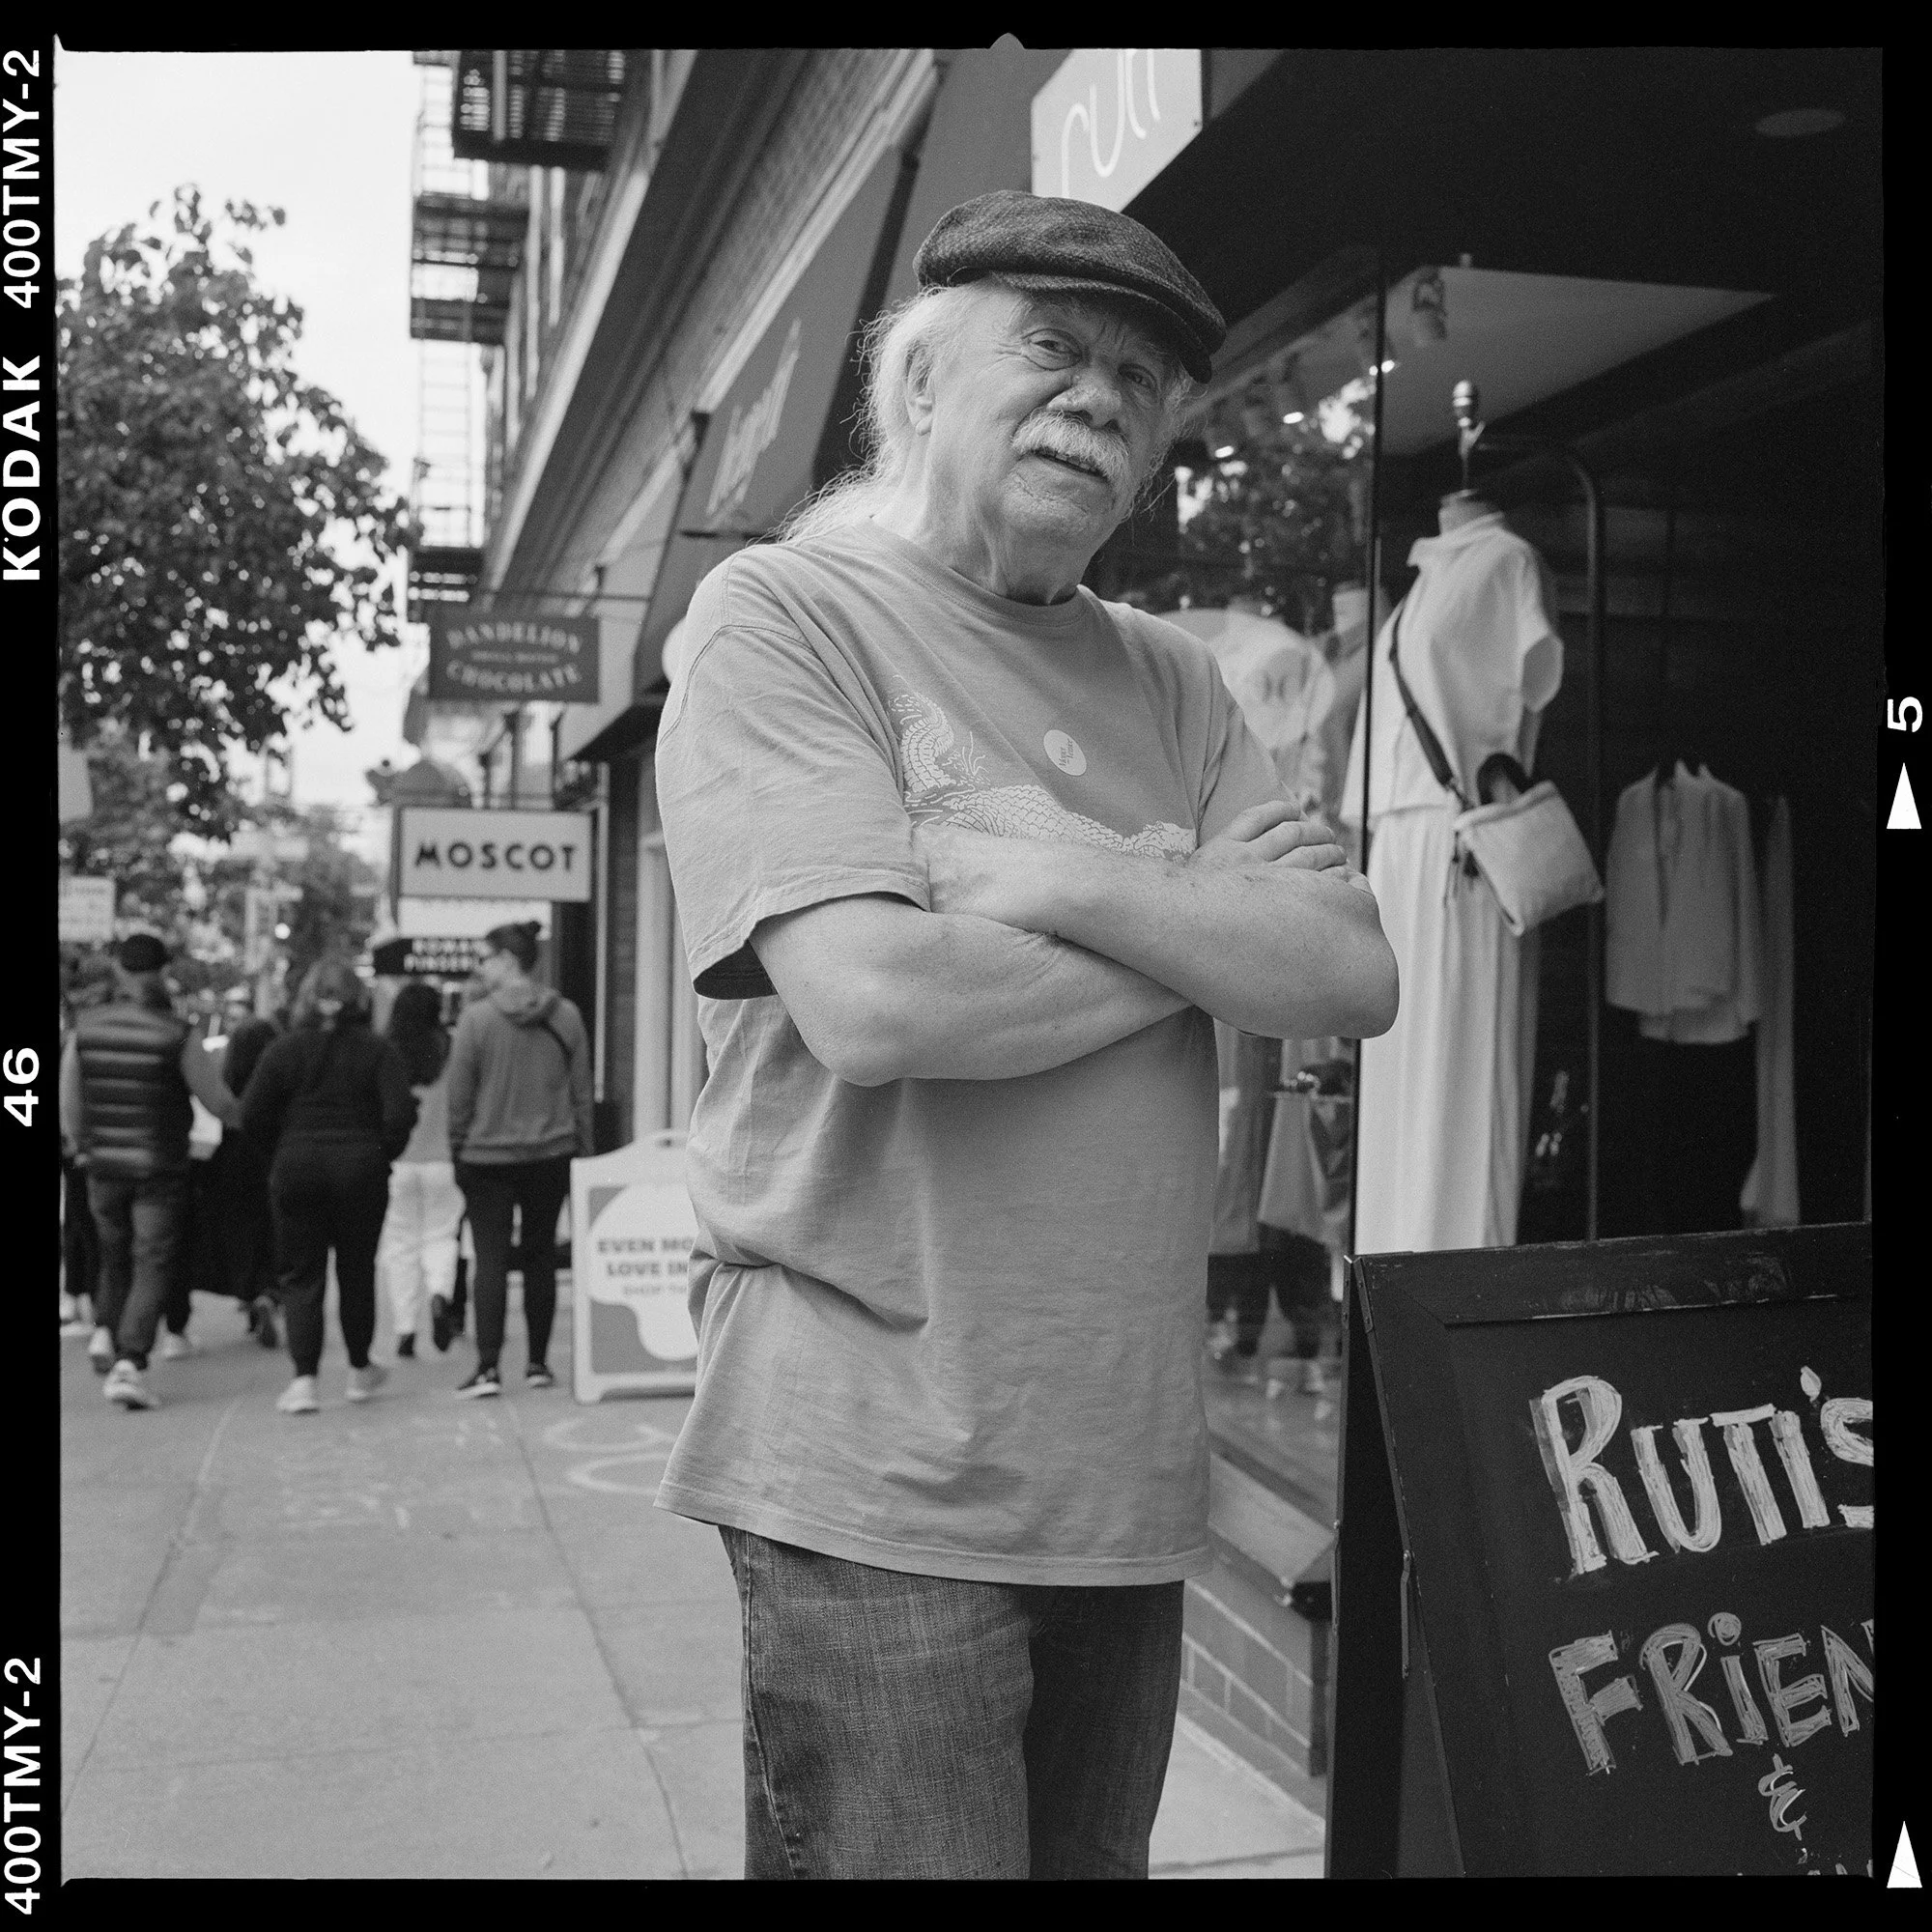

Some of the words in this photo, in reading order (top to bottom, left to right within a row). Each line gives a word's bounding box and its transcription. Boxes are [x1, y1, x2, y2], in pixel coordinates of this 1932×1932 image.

[3, 49, 41, 309] 400TMY-2
[2, 355, 41, 582] KODAK
[446, 621, 582, 655] DANDELION
[446, 658, 582, 694] CHOCOLATE
[1887, 696, 1923, 733] 5
[415, 840, 579, 872] MOSCOT
[3, 1047, 40, 1127] 46
[597, 1237, 655, 1254] EVEN
[607, 1261, 661, 1277] LOVE
[3, 1657, 42, 1916] 400TMY-2
